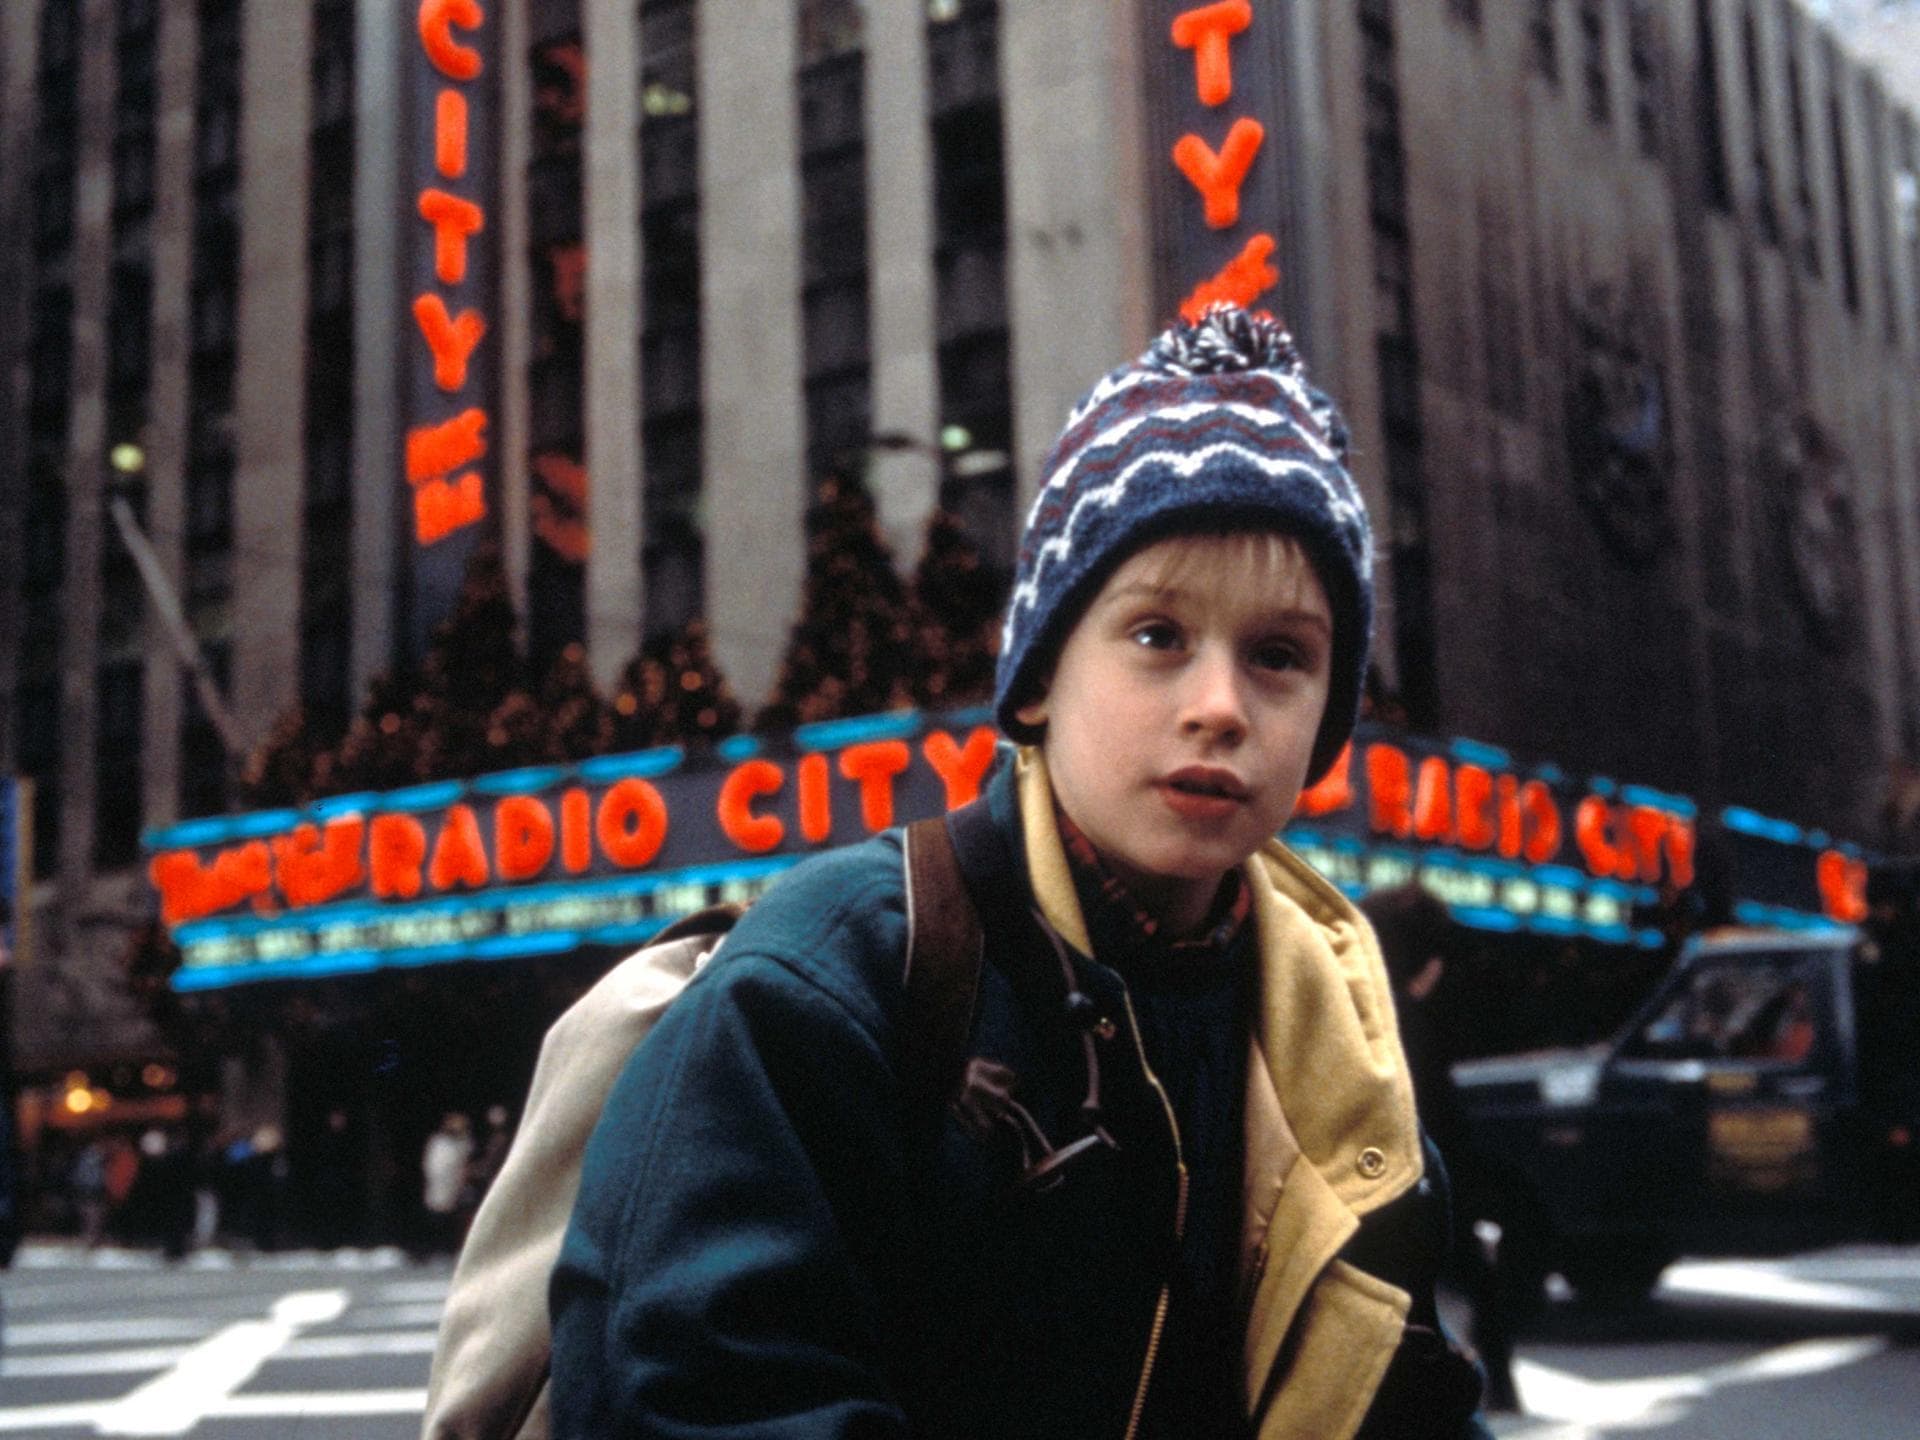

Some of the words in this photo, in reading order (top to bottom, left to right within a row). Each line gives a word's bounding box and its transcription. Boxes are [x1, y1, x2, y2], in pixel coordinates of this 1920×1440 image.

[411, 0, 486, 391] CITY
[368, 776, 669, 898] RADIO
[717, 725, 998, 853] CITY
